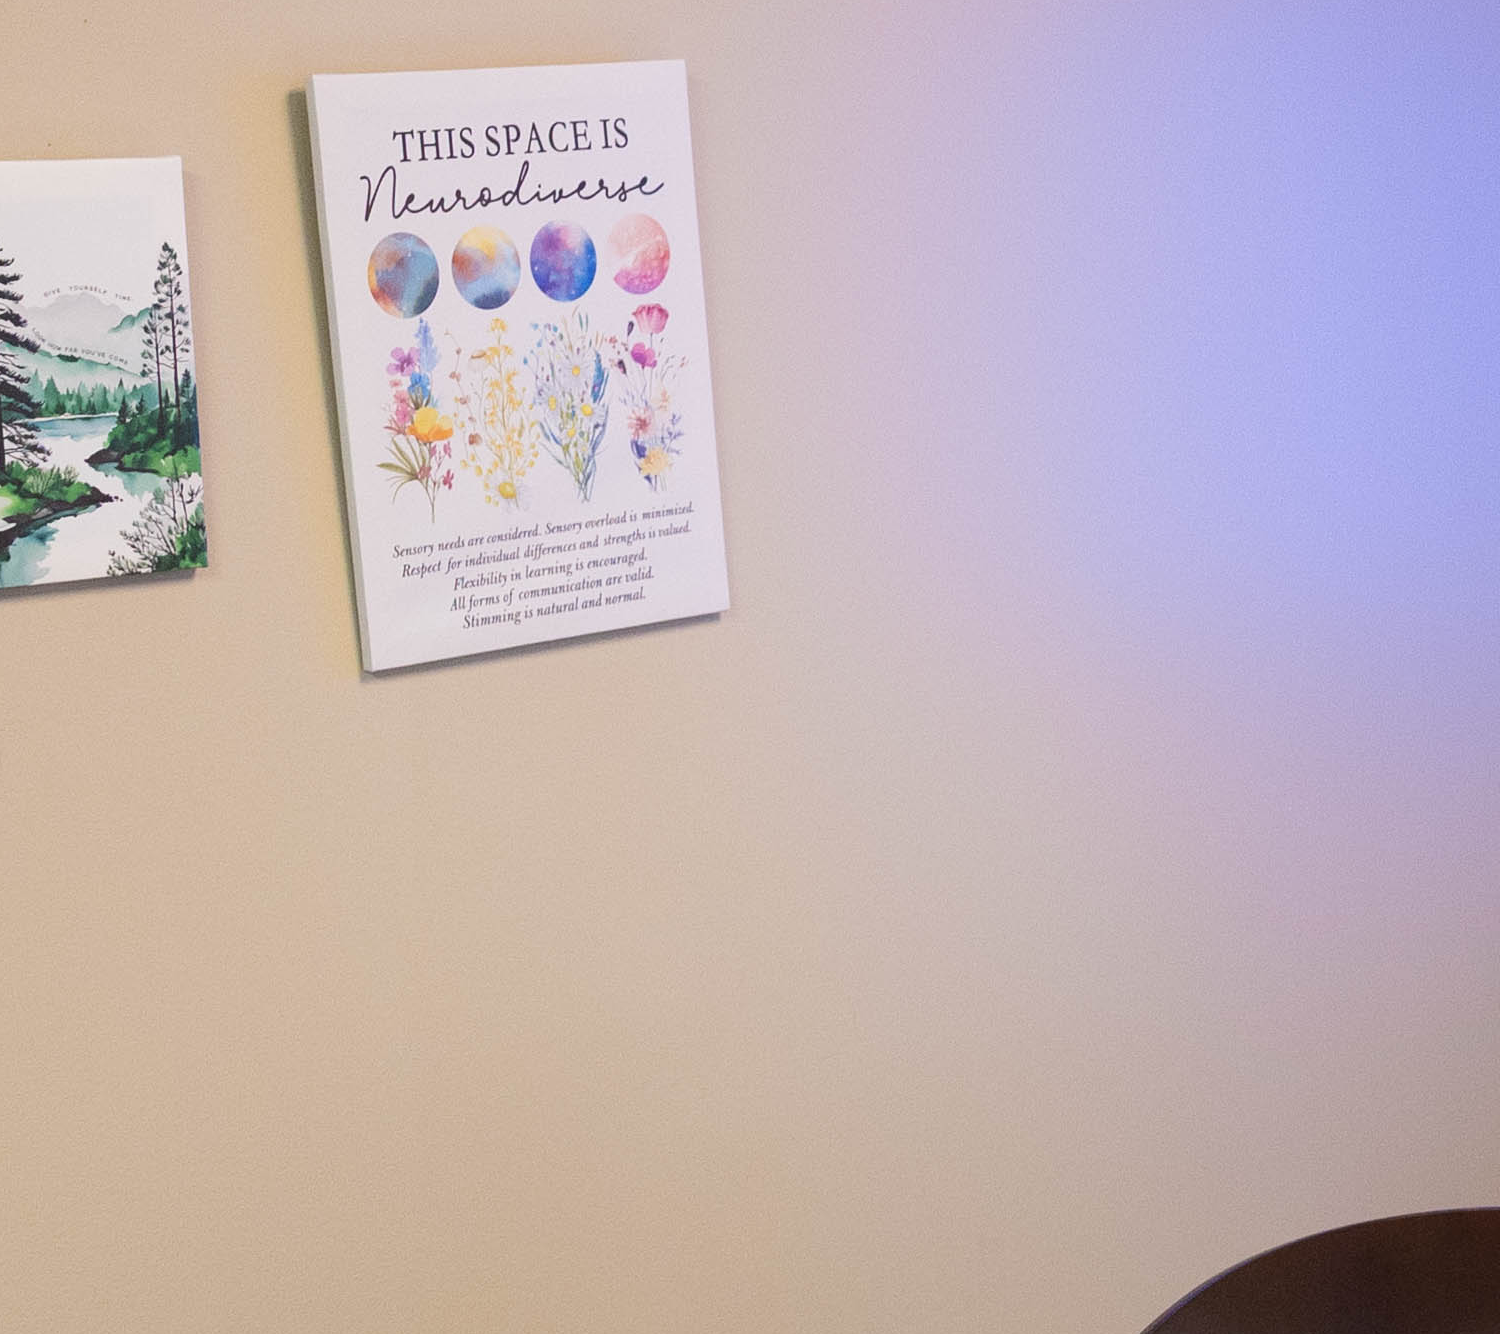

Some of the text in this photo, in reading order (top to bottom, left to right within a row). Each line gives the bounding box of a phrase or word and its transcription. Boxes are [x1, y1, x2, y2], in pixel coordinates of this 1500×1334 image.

[392, 117, 628, 164] THIS SPACE IS
[360, 160, 664, 222] Neurodiverse
[392, 503, 694, 559] Sensory needs are considered. Sensory overload is minimized.
[402, 521, 691, 579] Respect for individual differences and strengths is valued.
[450, 566, 654, 612] All forms of communication are valid.
[454, 549, 648, 591] Flexibility in learning is encouraged.
[463, 588, 646, 629] Stimming is natural and normal.
